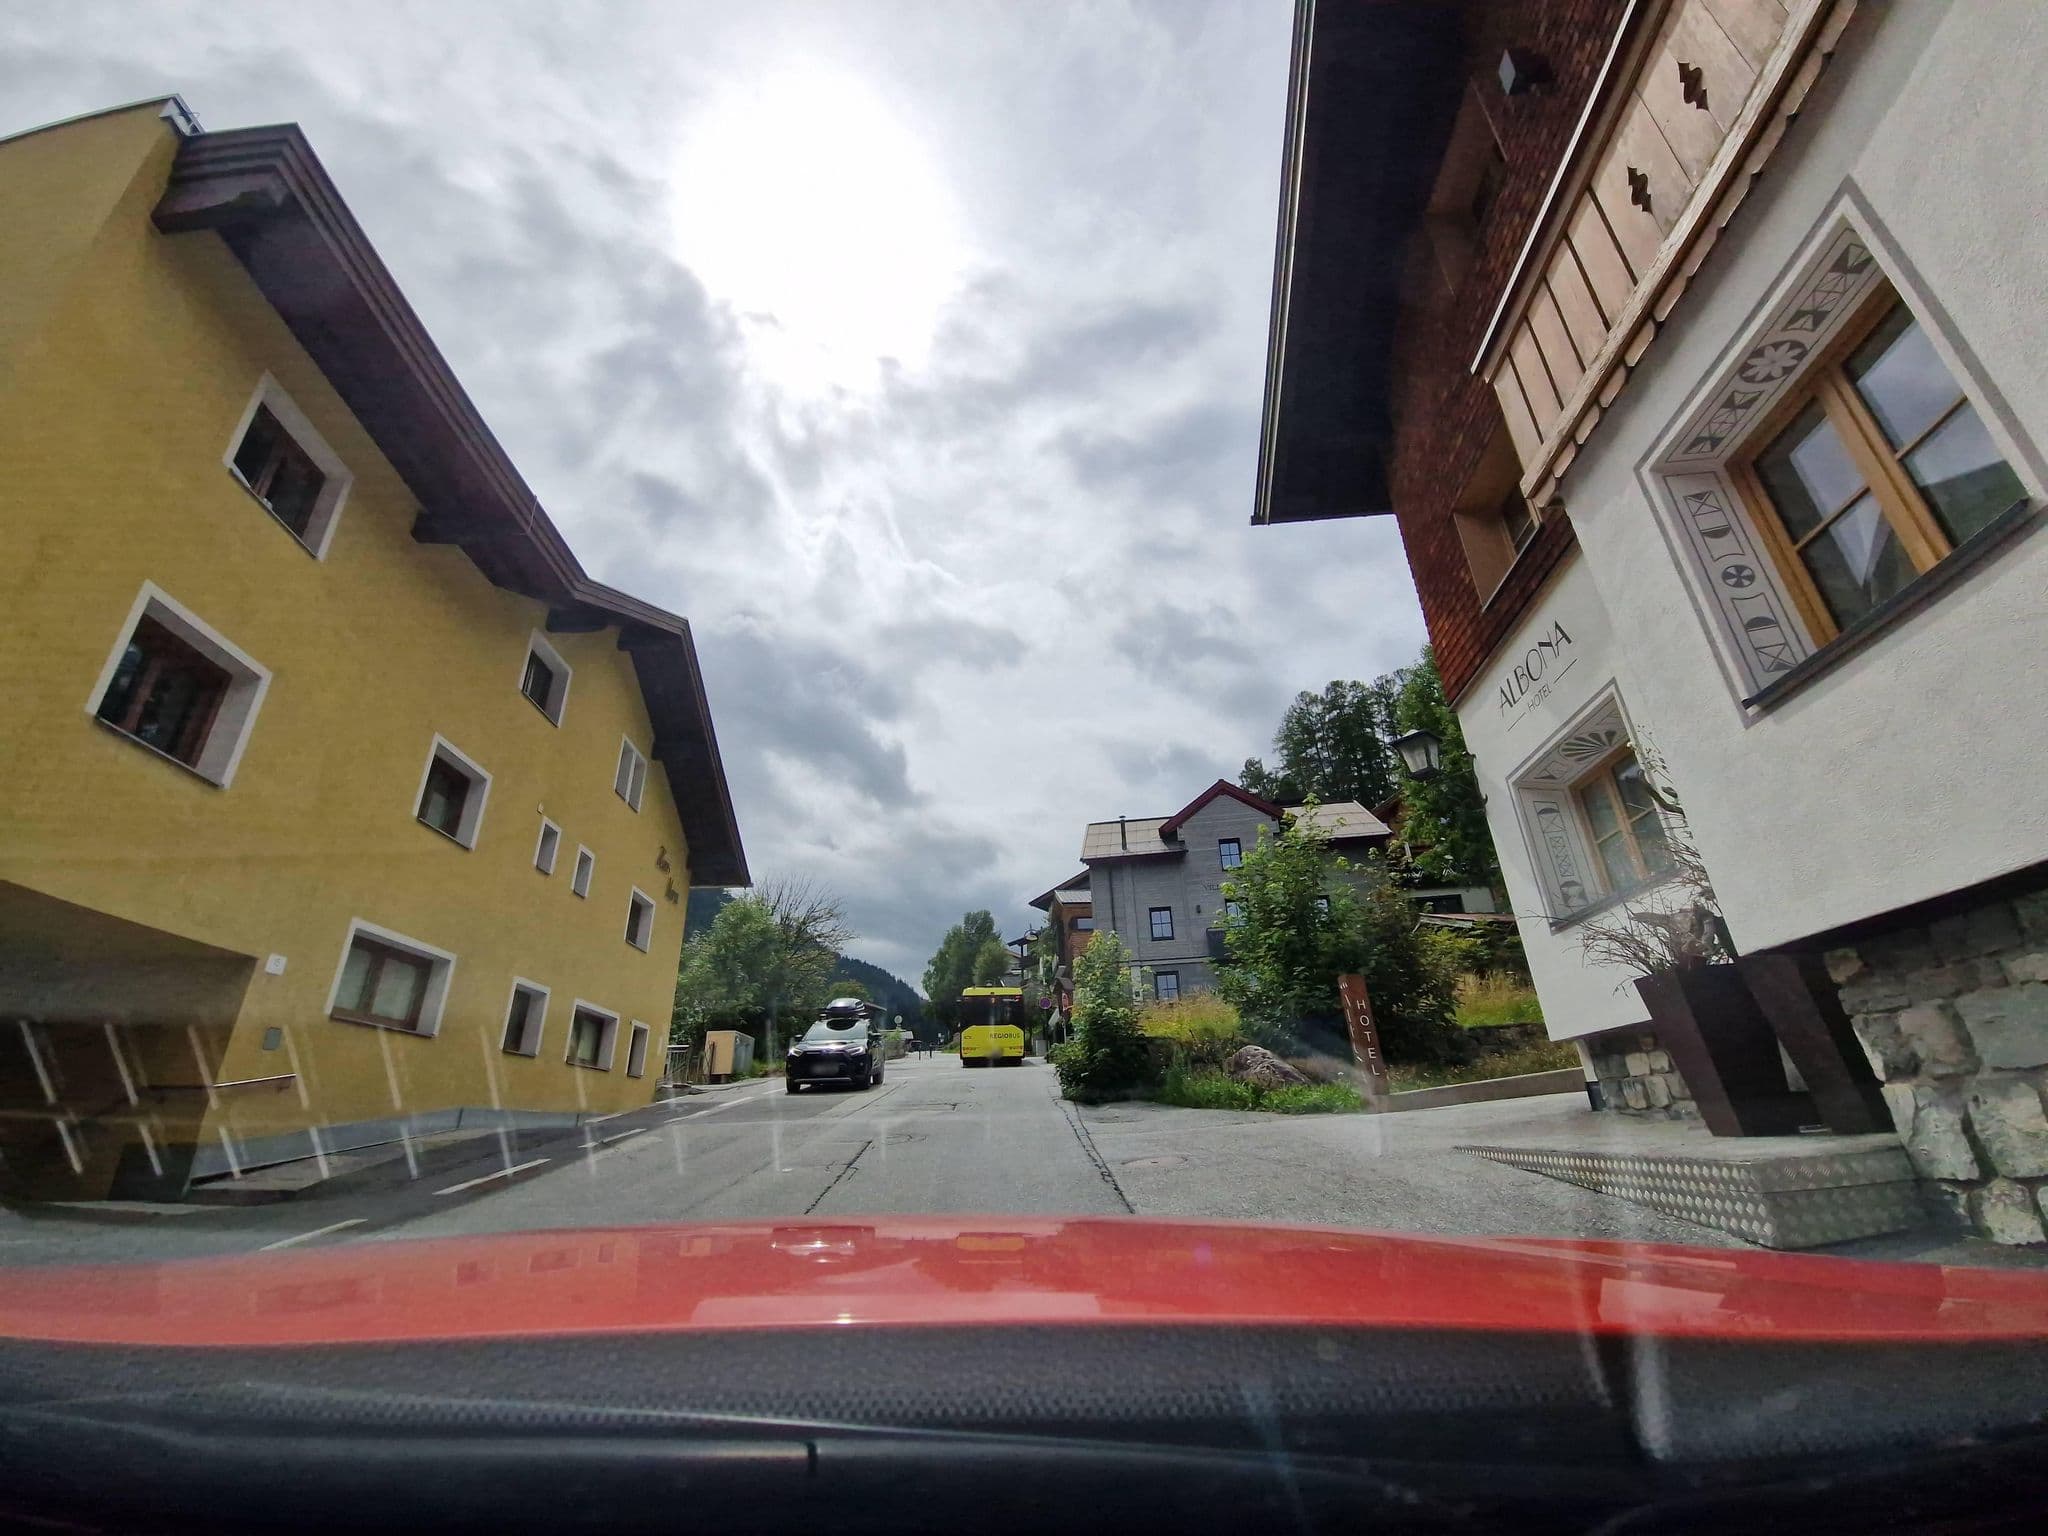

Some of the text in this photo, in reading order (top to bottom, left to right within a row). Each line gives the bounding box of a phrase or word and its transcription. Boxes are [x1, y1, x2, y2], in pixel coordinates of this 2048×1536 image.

[1500, 620, 1572, 717] ALBONA
[1527, 682, 1553, 712] HOTEL
[1357, 999, 1380, 1076] HOTEL
